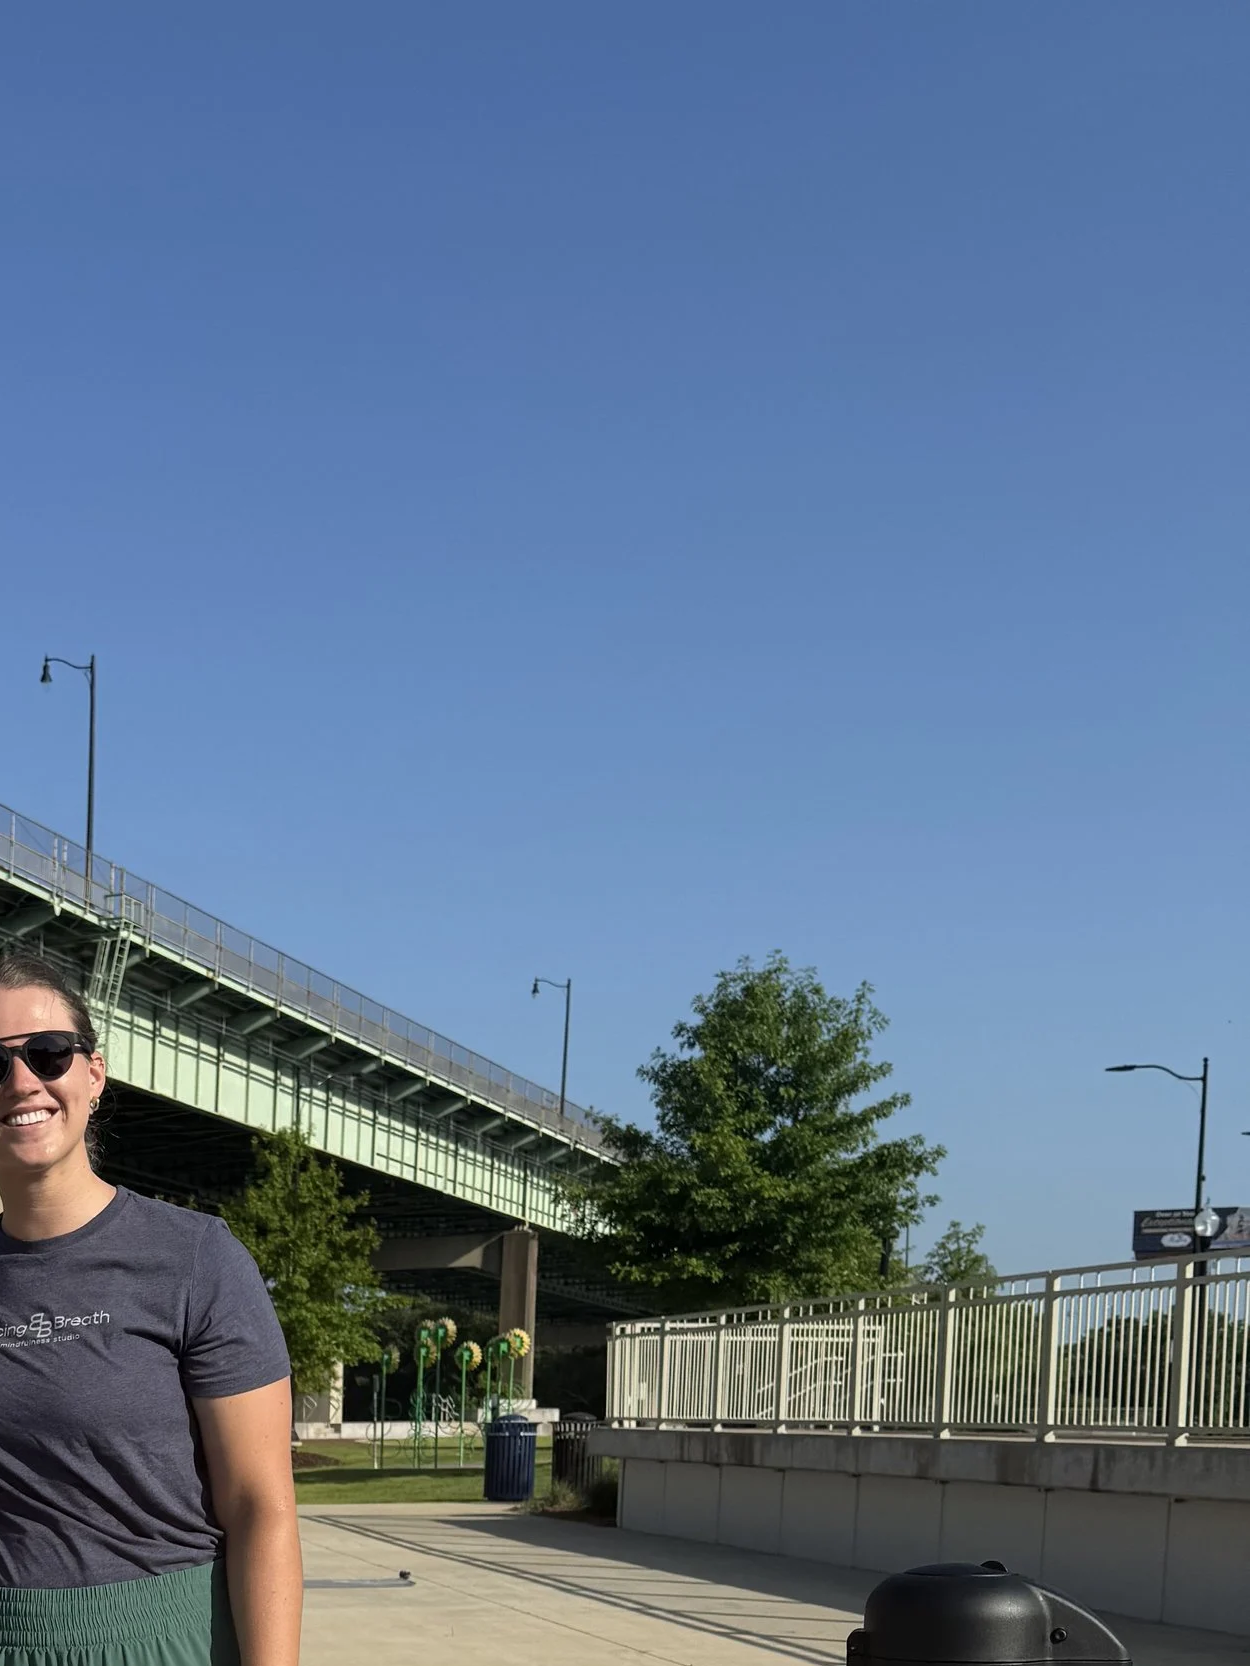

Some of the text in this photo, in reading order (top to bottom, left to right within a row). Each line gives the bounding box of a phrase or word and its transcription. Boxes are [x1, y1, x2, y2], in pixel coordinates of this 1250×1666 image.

[54, 1310, 110, 1330] Breath
[0, 1337, 50, 1349] mindfulness
[53, 1333, 80, 1343] studio
